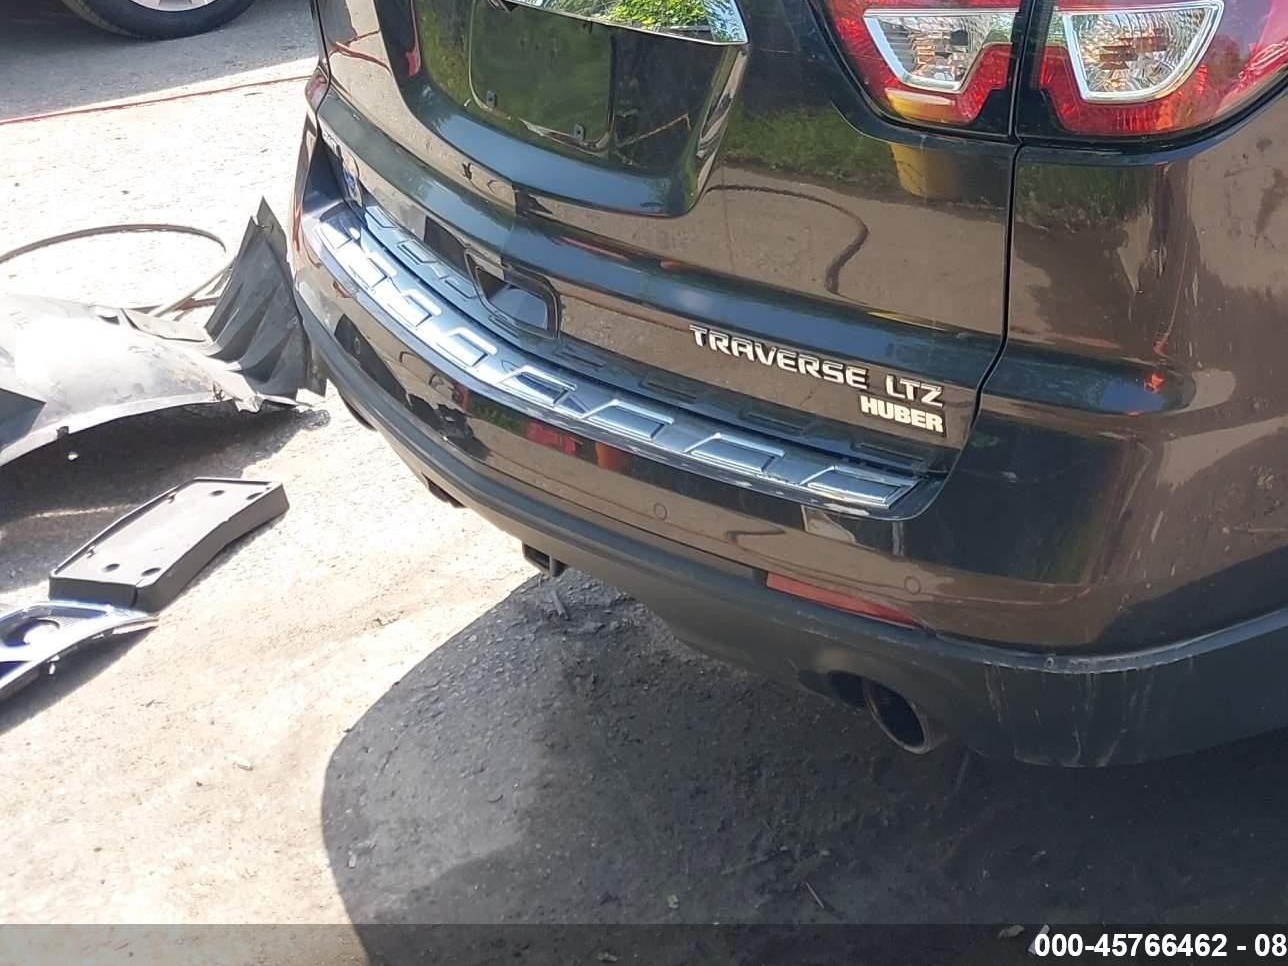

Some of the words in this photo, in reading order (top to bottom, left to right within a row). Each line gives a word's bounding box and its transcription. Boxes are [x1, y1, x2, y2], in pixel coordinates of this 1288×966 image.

[689, 324, 868, 390] TRAVERSE
[886, 374, 945, 407] LTZ
[860, 396, 945, 434] HUBER
